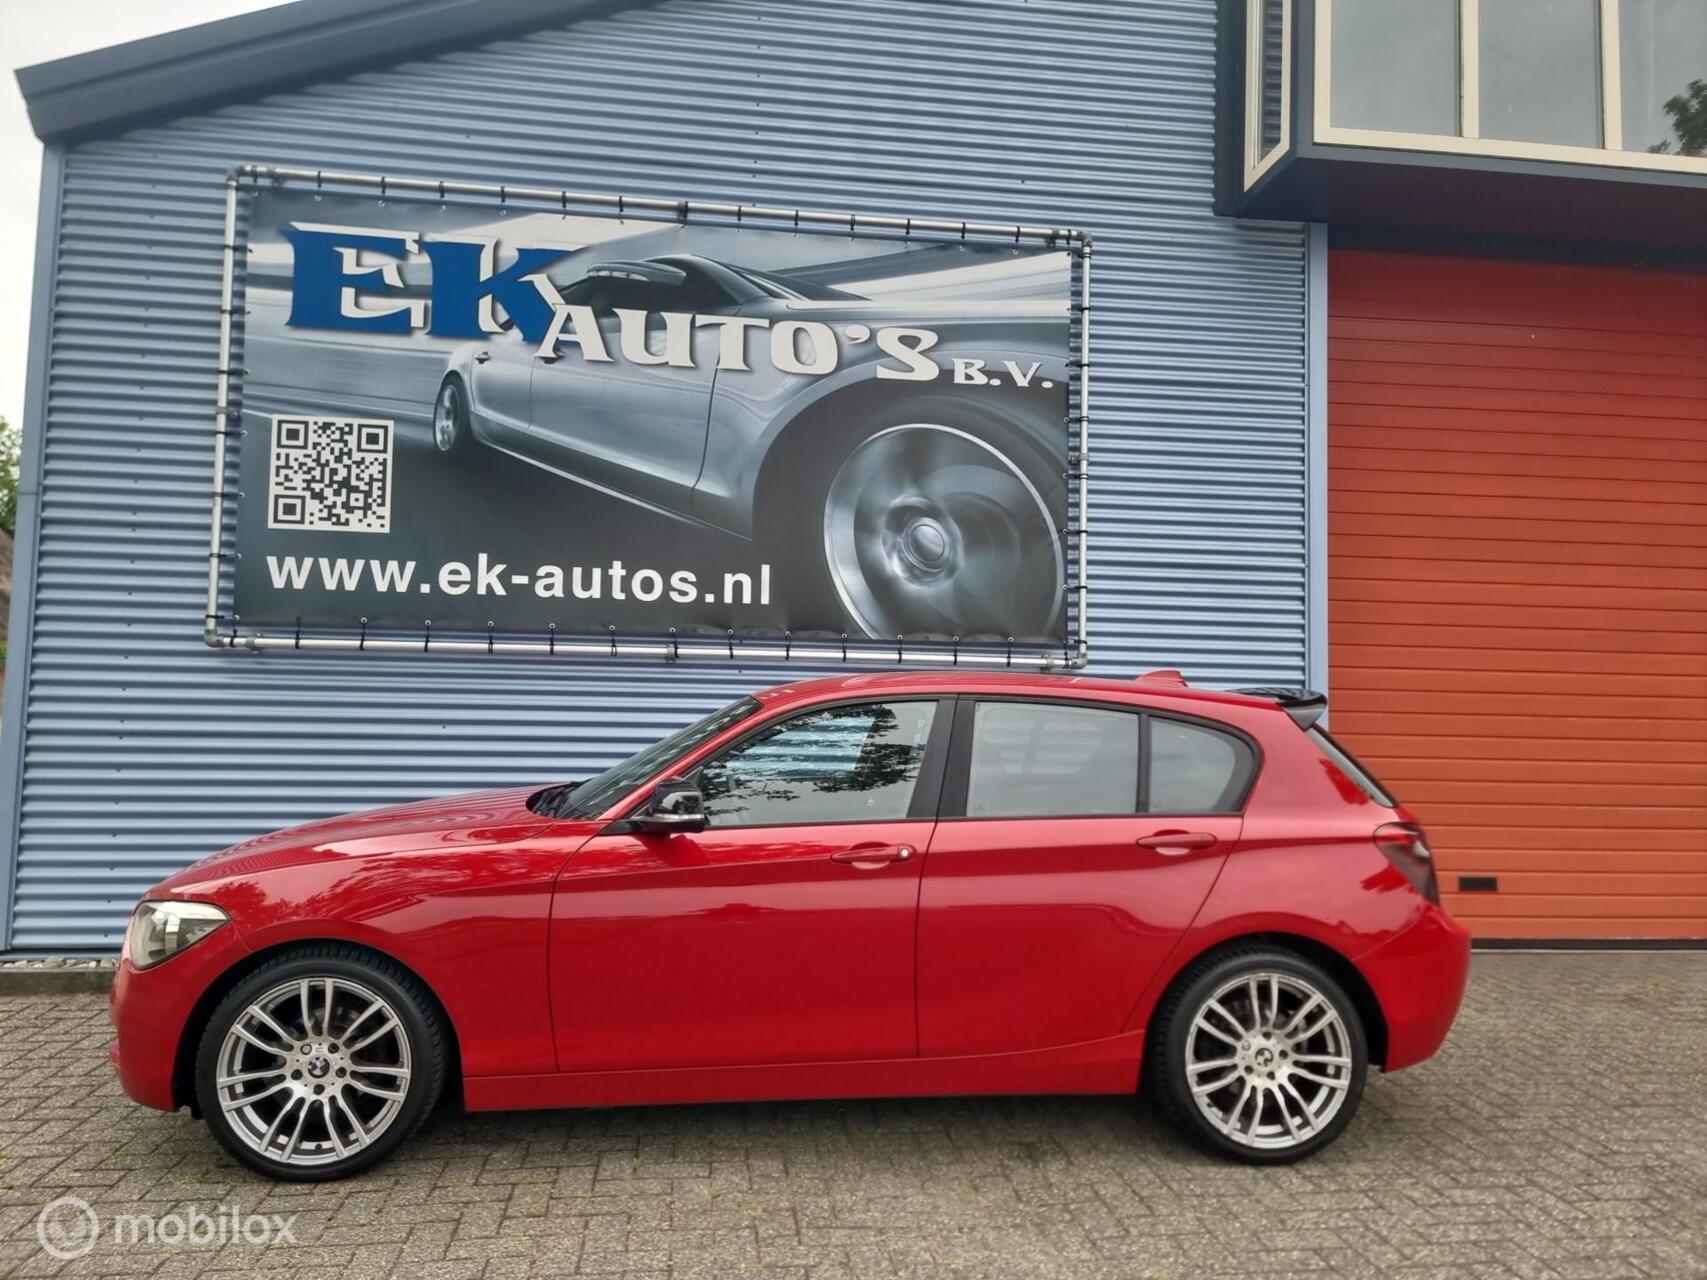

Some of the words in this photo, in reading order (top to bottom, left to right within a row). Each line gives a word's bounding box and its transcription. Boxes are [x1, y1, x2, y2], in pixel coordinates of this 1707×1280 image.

[278, 221, 590, 344] EK
[952, 357, 1054, 389] B.V.
[266, 552, 771, 605] www.ek-autos.nl
